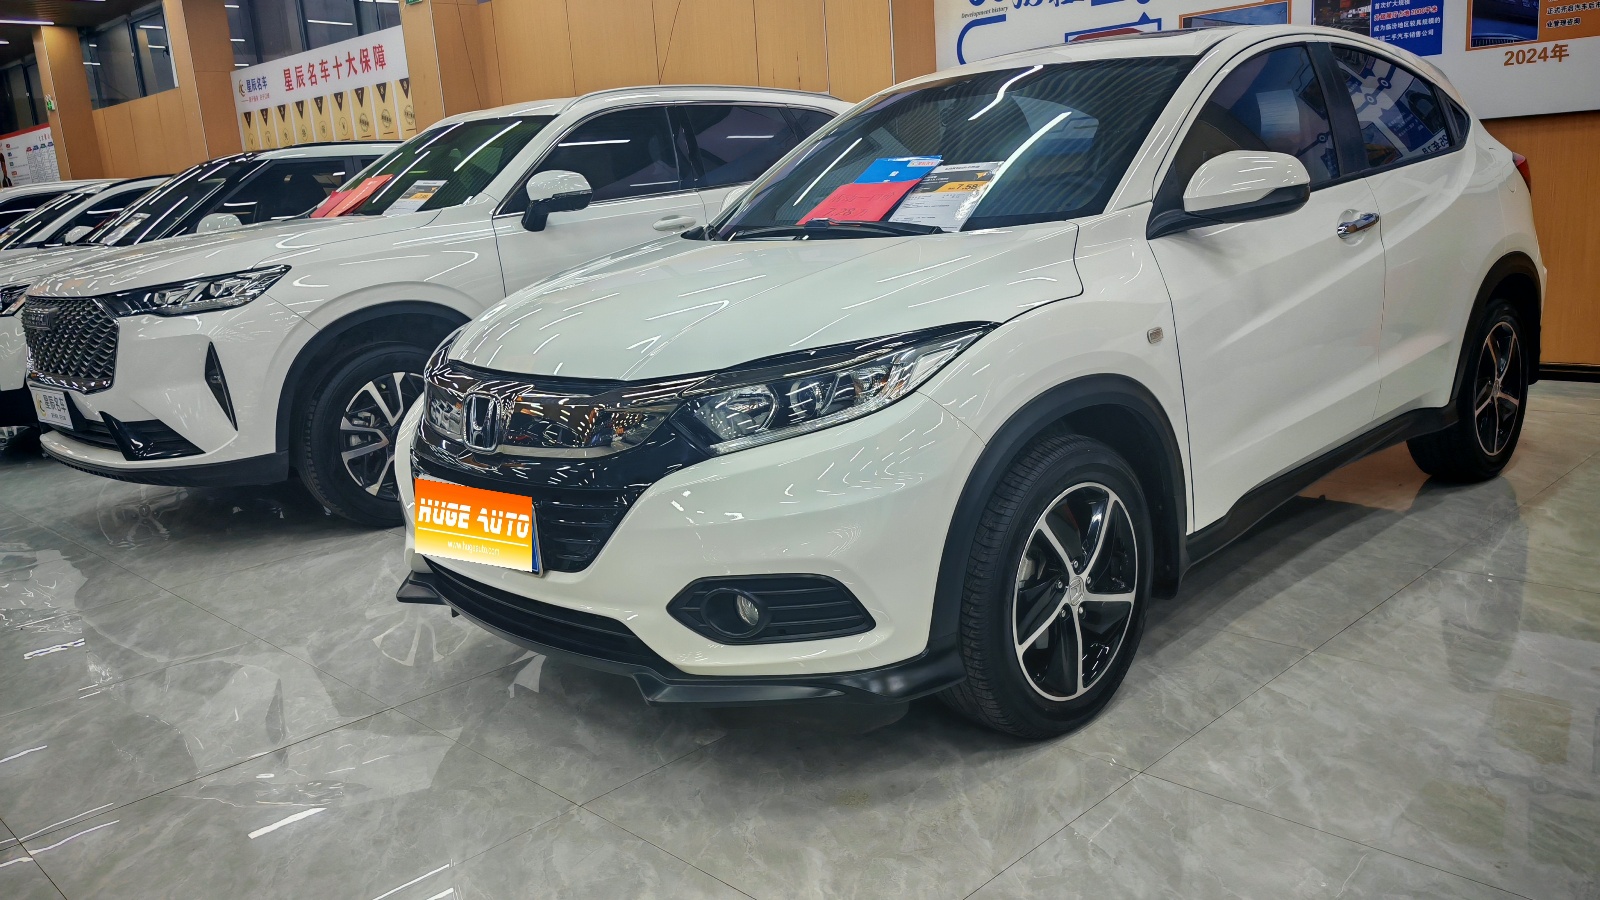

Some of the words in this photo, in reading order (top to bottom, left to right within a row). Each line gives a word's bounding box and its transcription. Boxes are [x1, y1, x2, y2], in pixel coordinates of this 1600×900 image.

[961, 8, 992, 19] Development
[1503, 43, 1570, 66] 2024年
[283, 44, 387, 92] 星辰名车十大保障
[246, 76, 268, 93] 星辰名车
